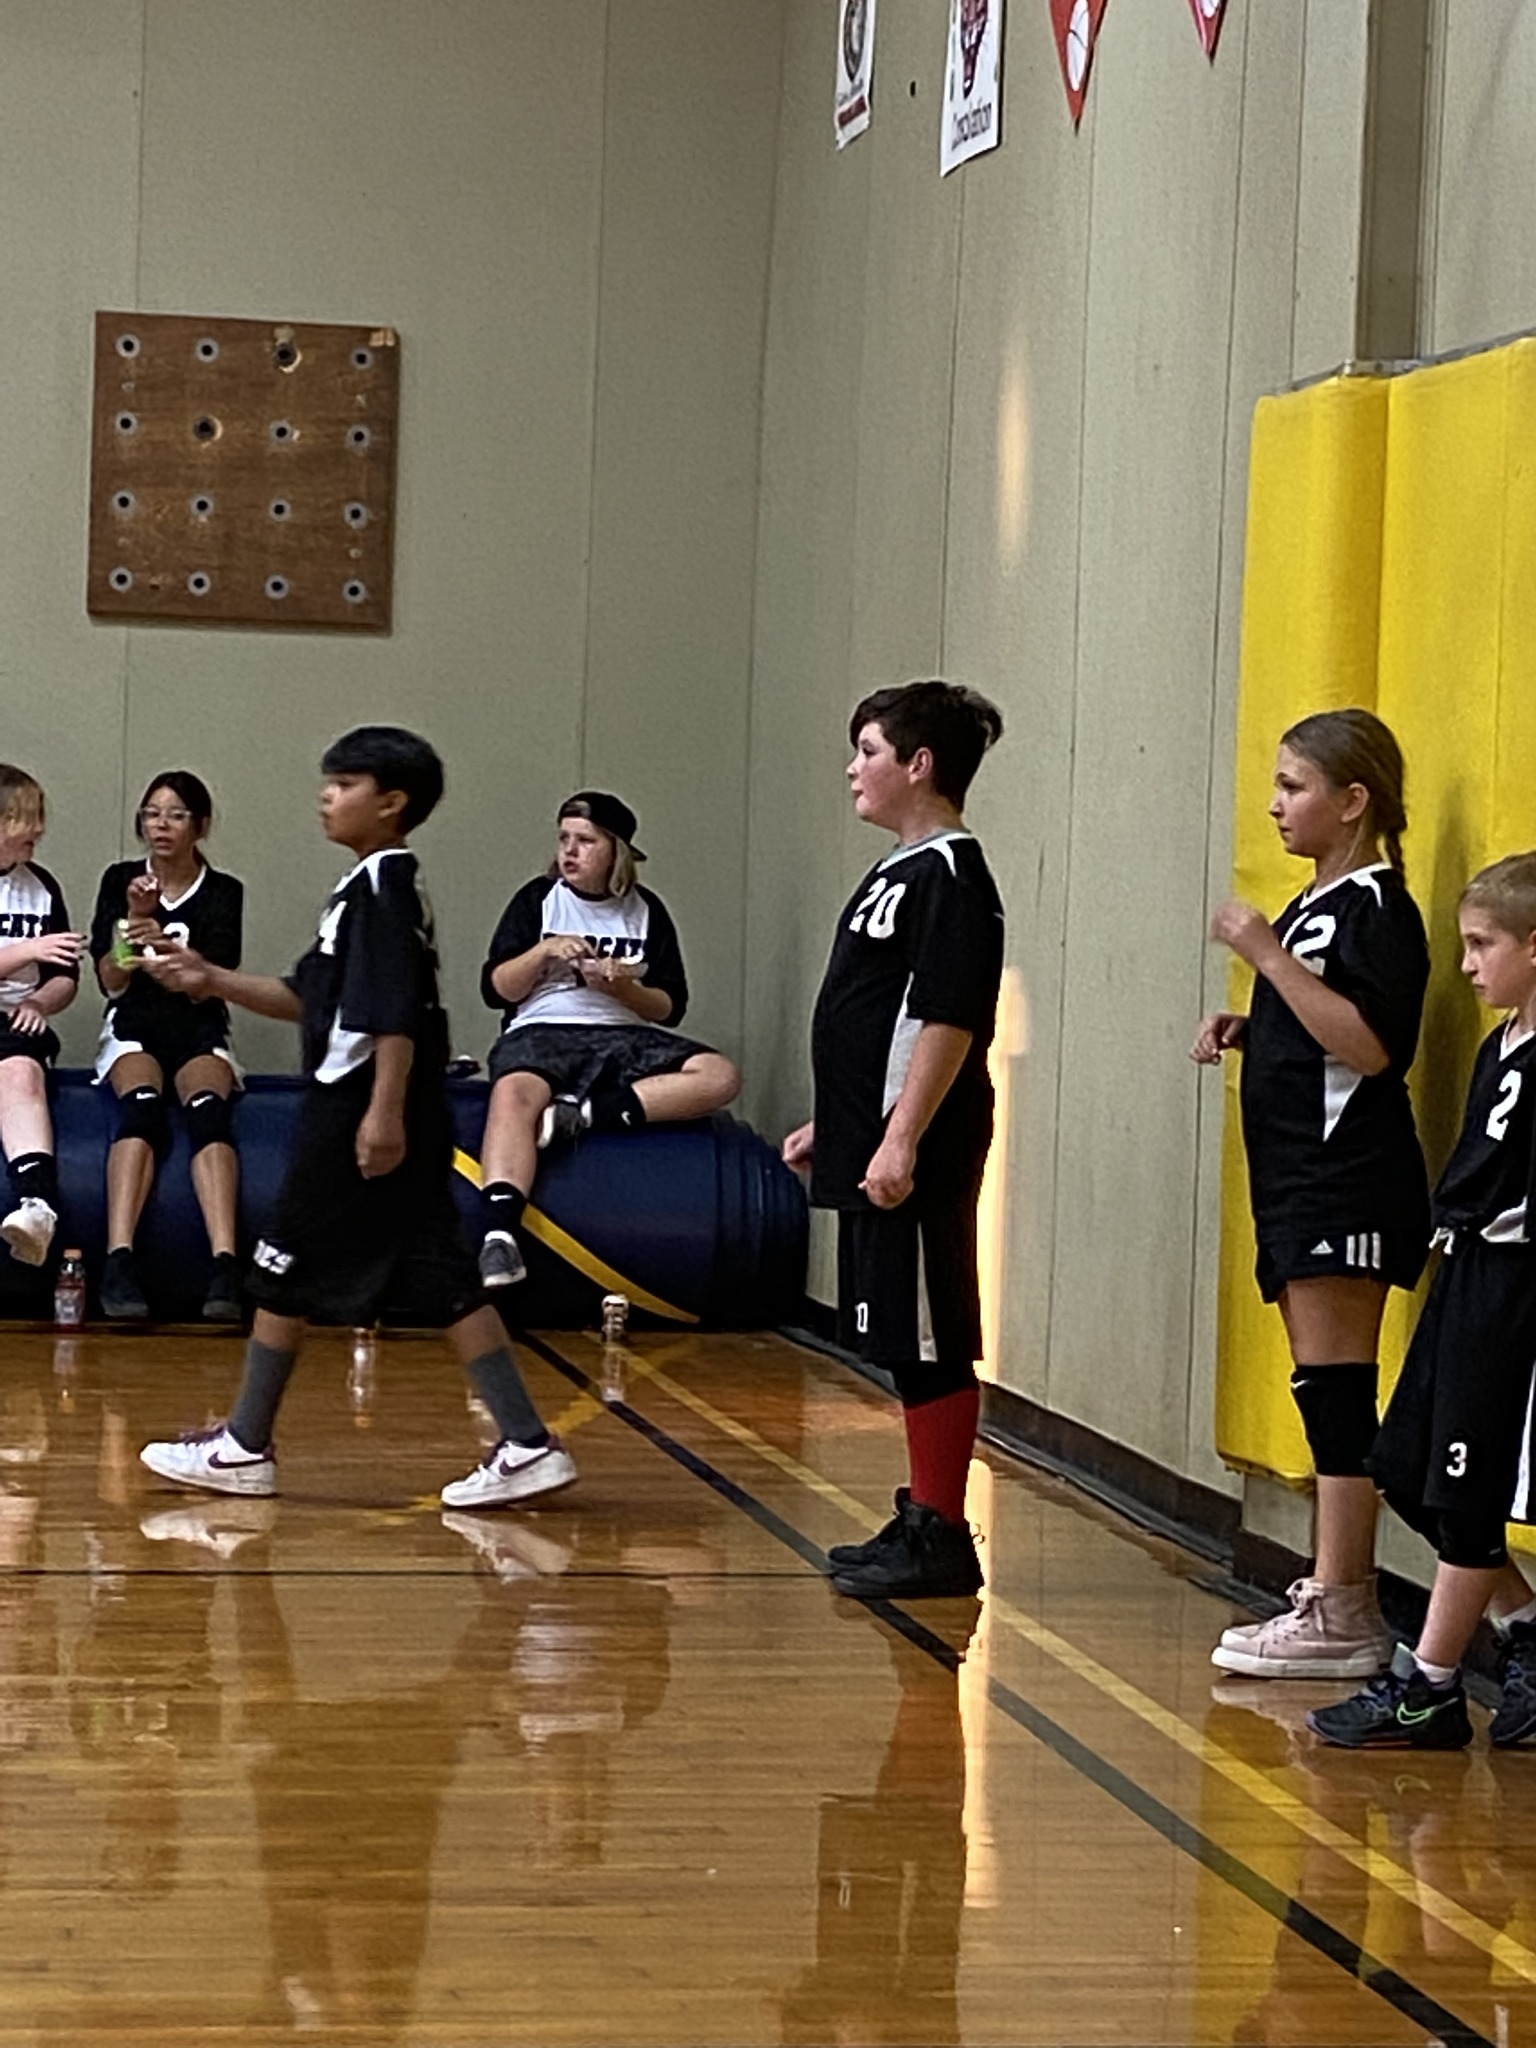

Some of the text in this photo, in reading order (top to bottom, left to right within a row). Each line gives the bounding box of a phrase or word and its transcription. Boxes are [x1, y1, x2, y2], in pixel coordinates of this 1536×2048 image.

[849, 877, 907, 939] 20
[1486, 1069, 1522, 1141] 2
[1446, 1442, 1468, 1477] 3
